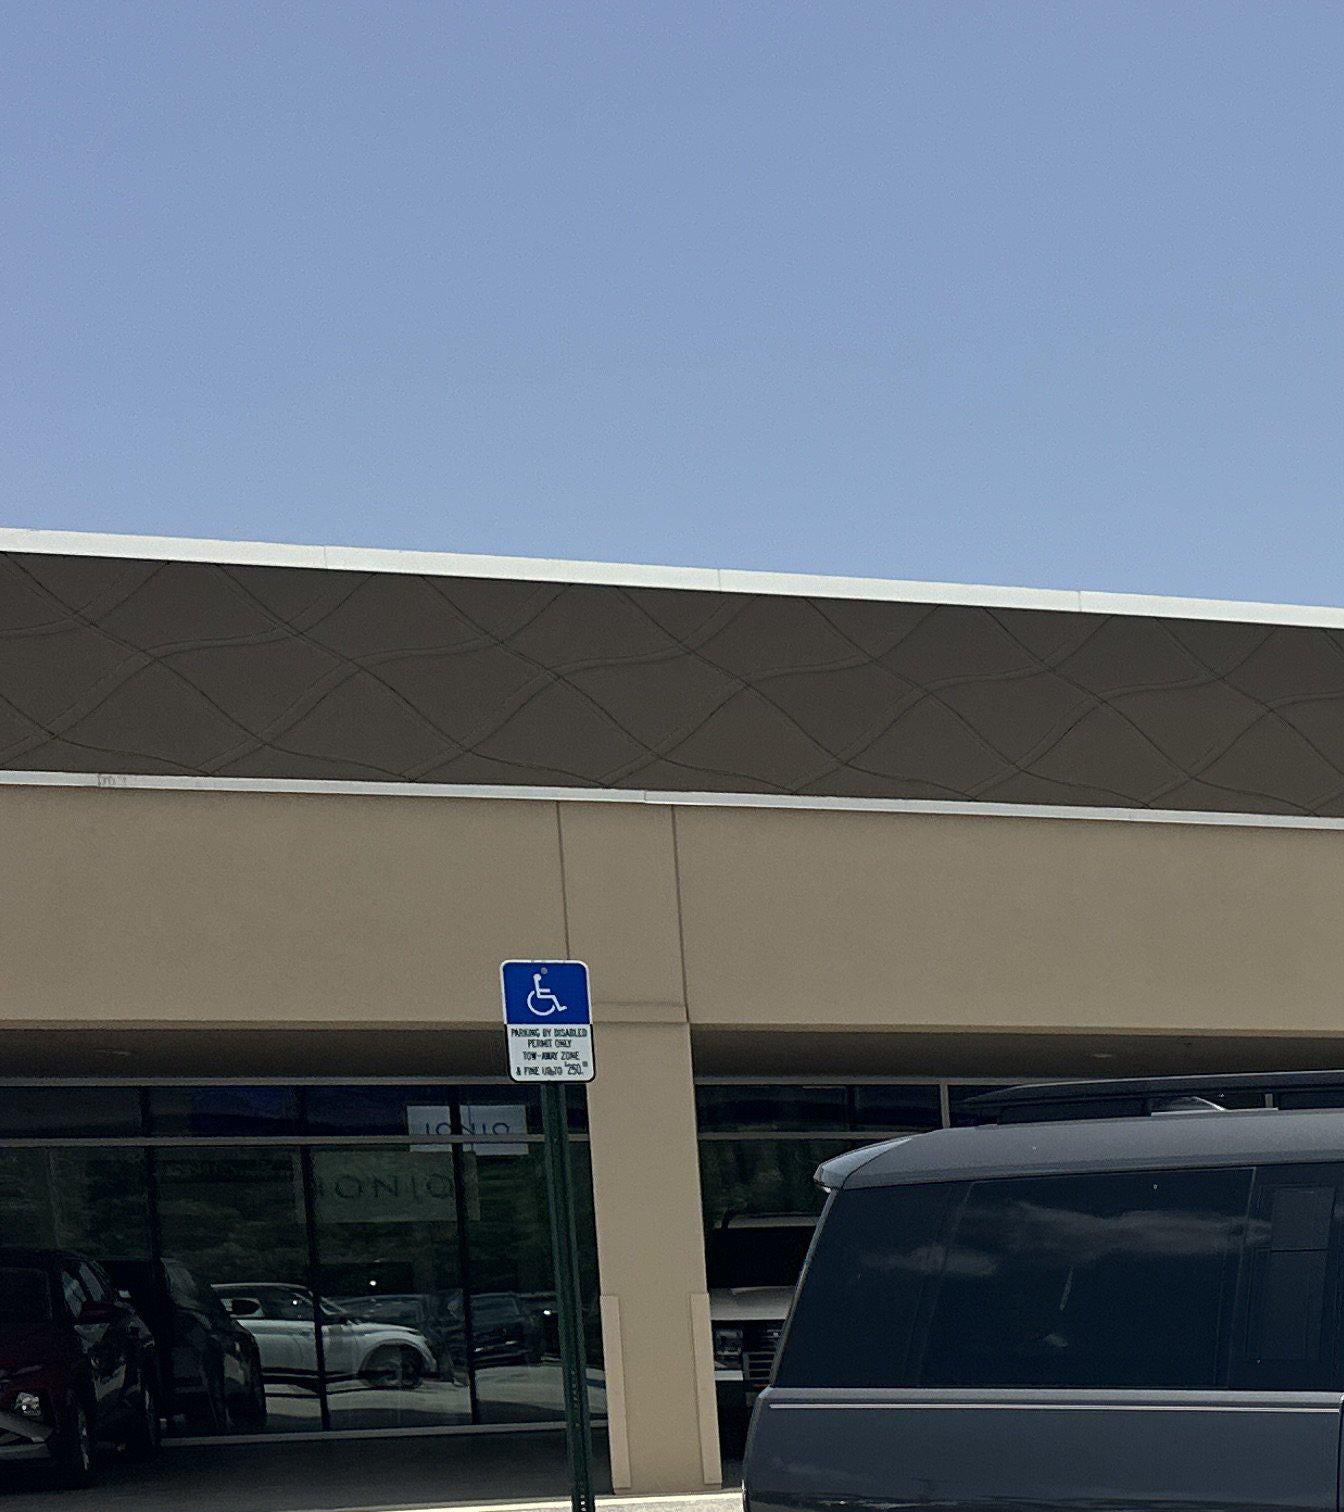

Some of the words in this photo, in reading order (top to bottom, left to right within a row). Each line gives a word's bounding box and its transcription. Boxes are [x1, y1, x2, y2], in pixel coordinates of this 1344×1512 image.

[511, 1028, 540, 1037] PARKING
[543, 1028, 552, 1037] BY
[554, 1028, 587, 1037] DISABLED
[527, 1038, 552, 1048] PERMIT
[554, 1038, 572, 1048] ONLY
[560, 1051, 580, 1061] ZONE
[523, 1066, 540, 1076] FINE
